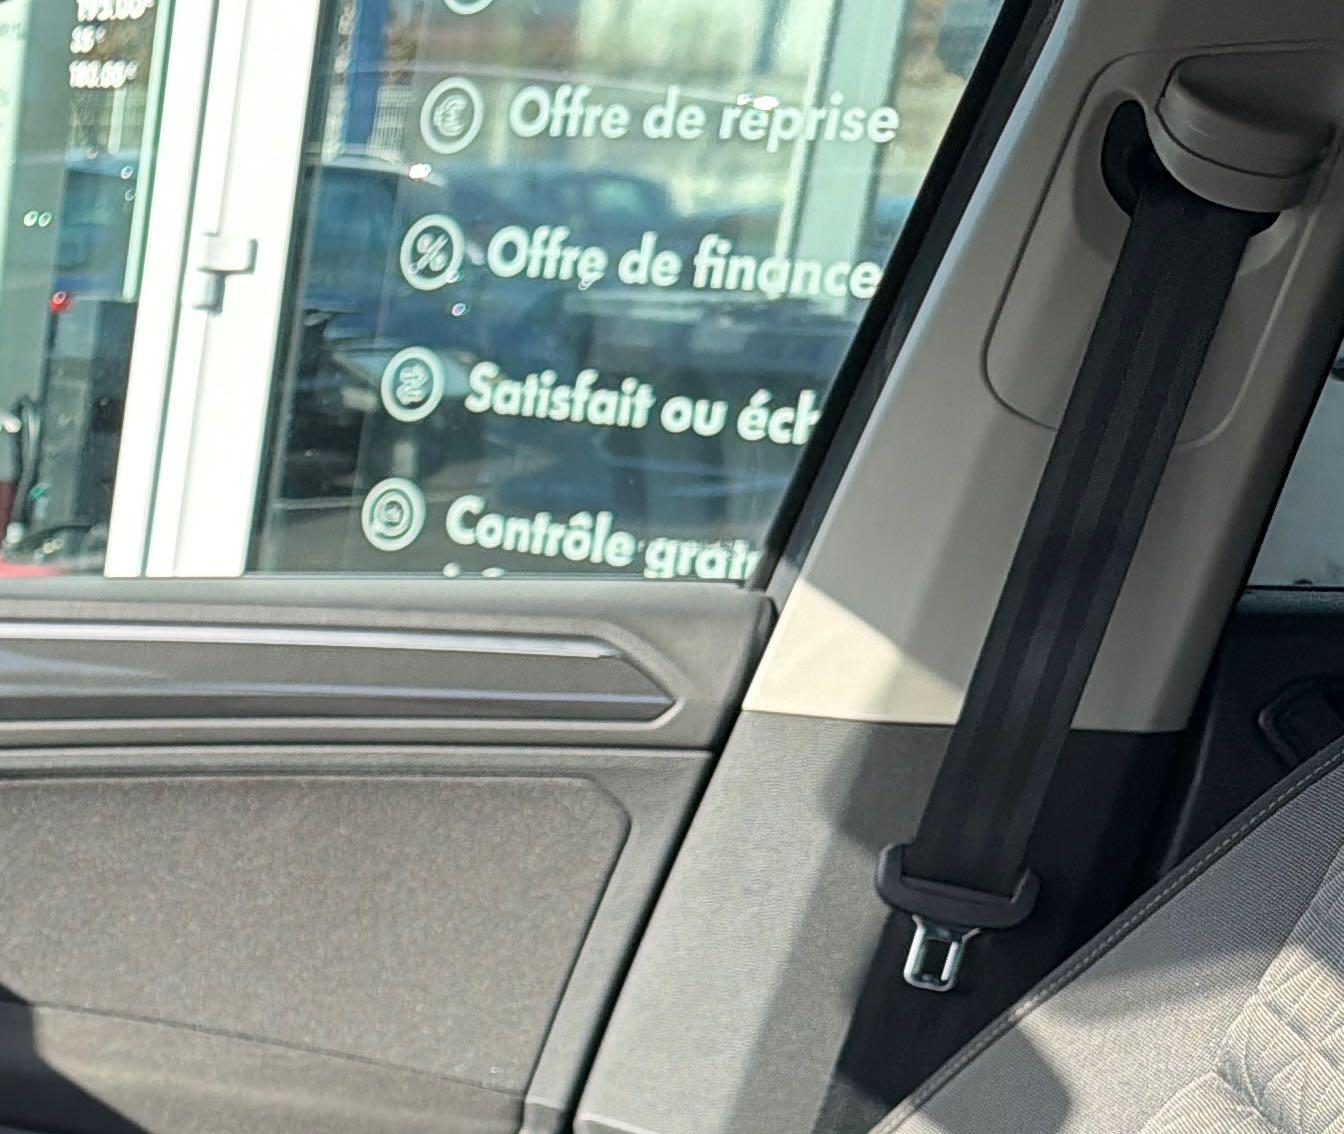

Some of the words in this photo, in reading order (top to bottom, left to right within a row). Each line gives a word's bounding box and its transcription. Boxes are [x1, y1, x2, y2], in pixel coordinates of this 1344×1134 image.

[511, 84, 630, 138] Offre
[643, 85, 706, 140] de
[719, 91, 900, 152] reprise
[487, 224, 608, 281] Offre
[617, 231, 682, 286] de
[465, 361, 656, 428] Satisfait
[660, 395, 728, 437] ou
[445, 494, 636, 567] Contrôle
